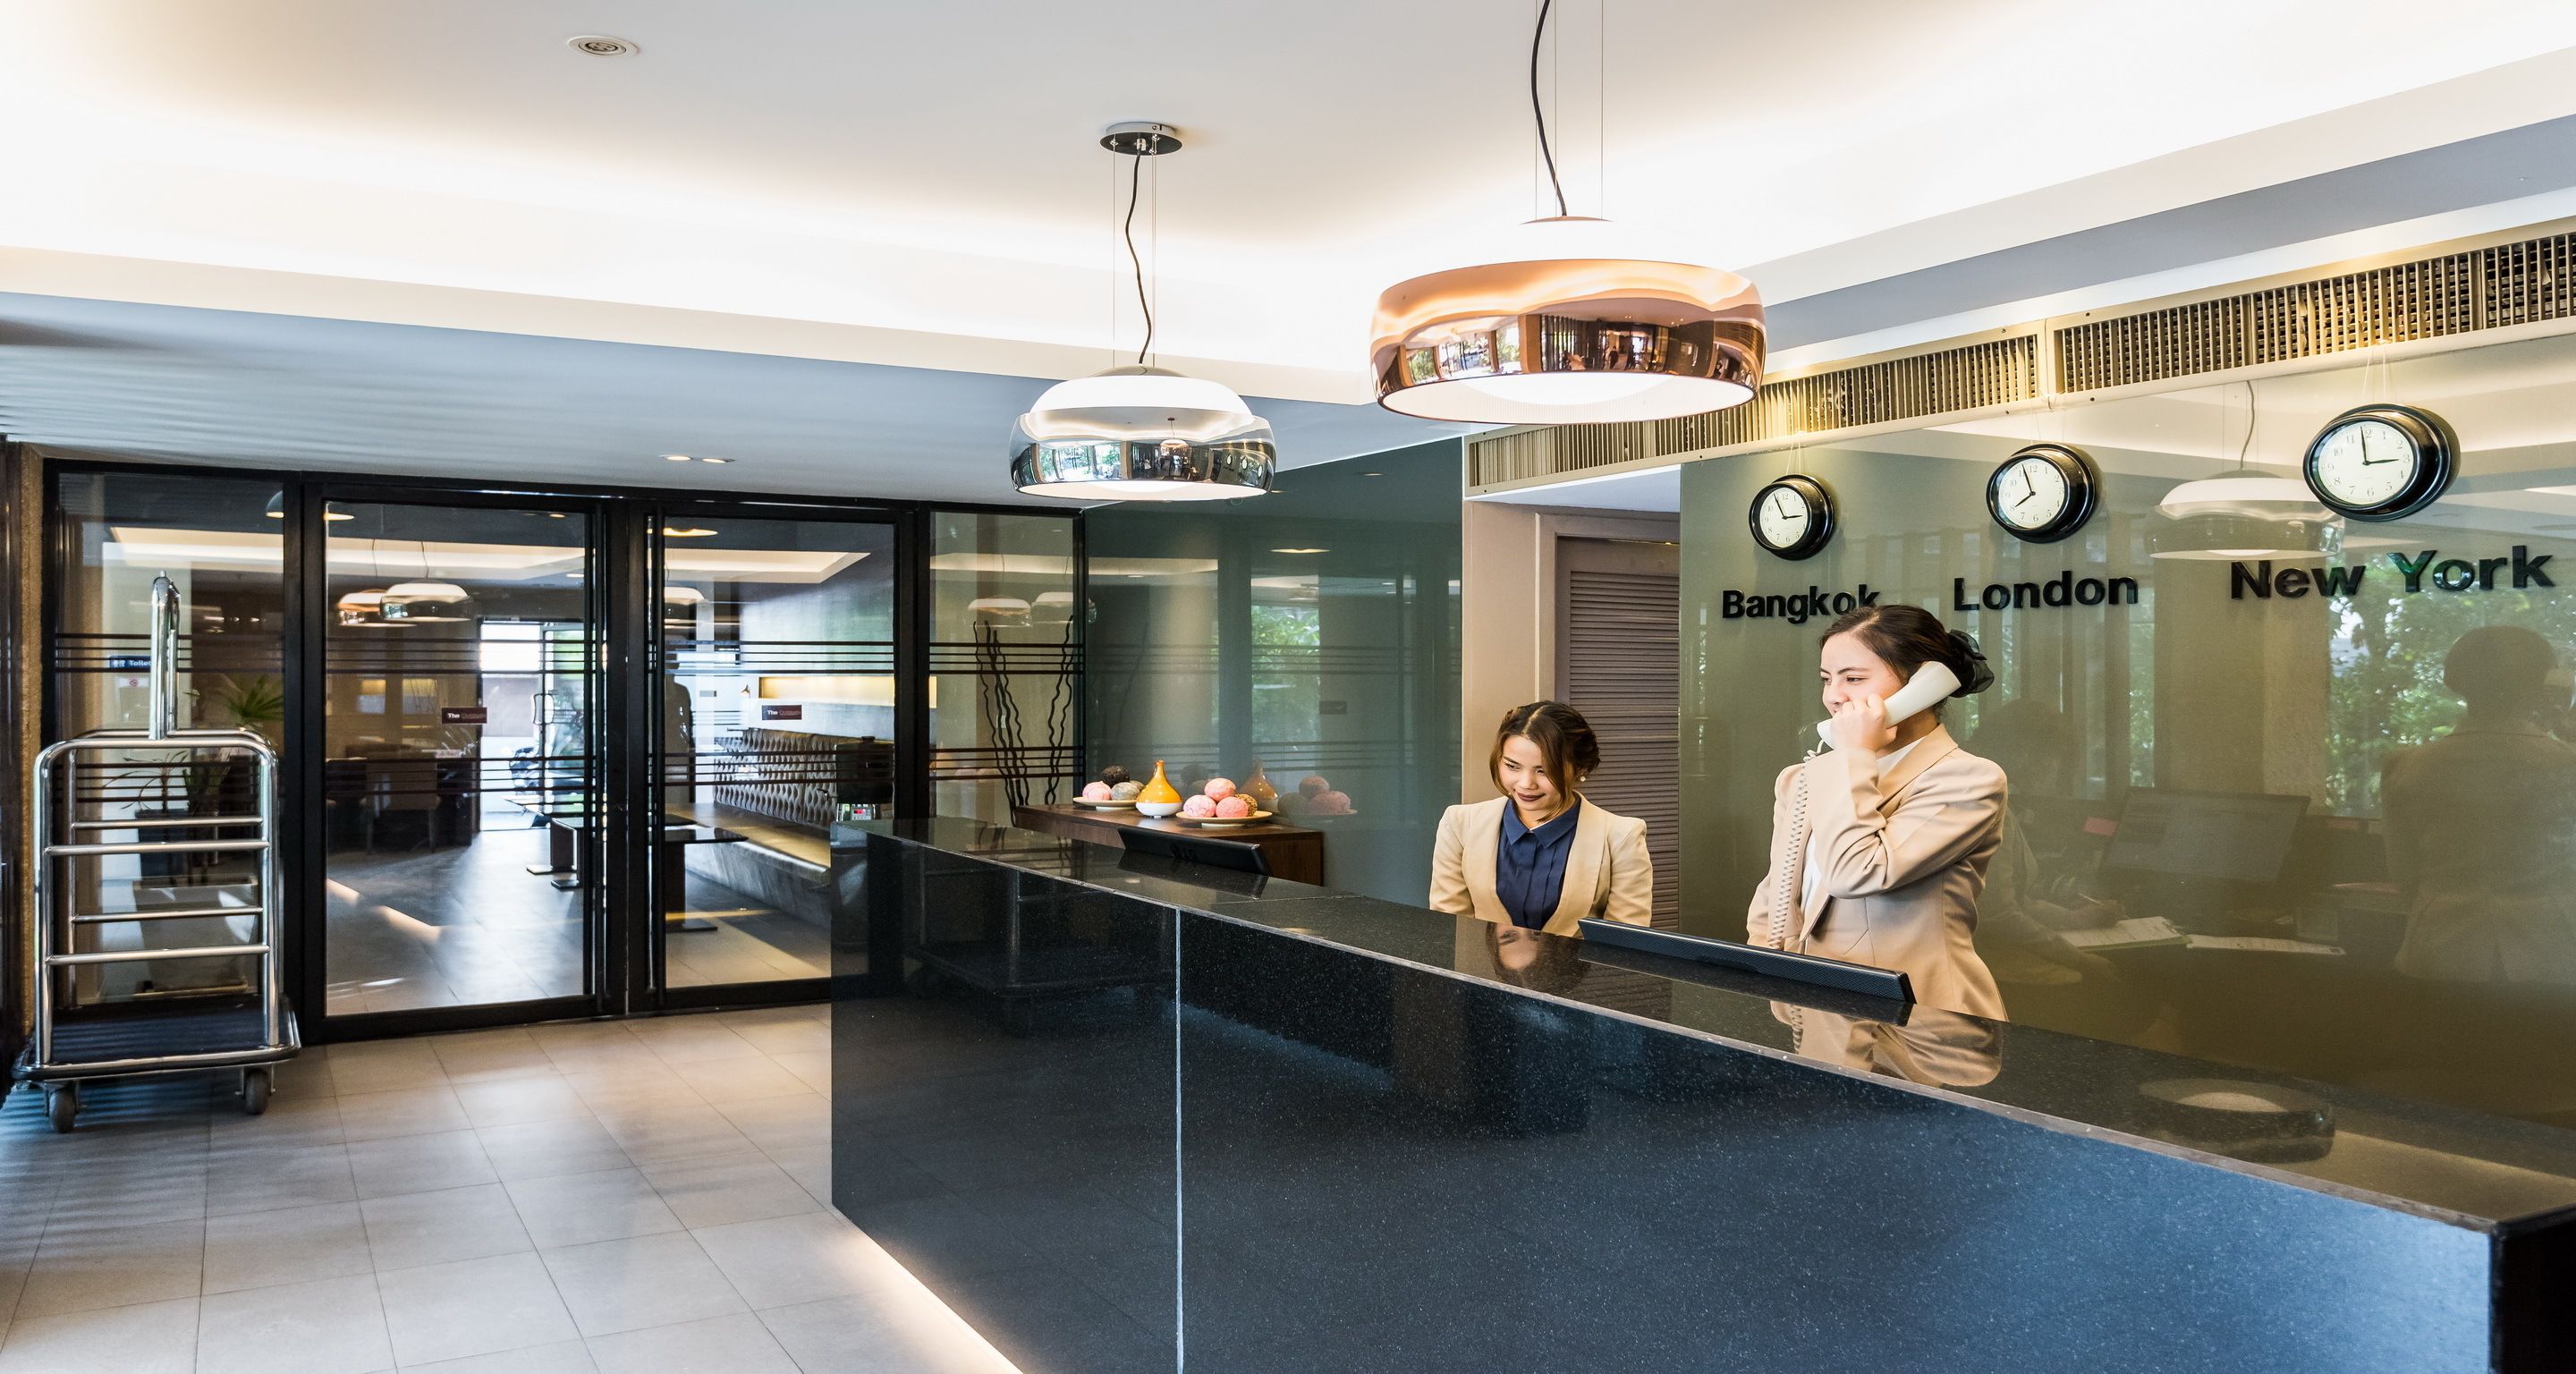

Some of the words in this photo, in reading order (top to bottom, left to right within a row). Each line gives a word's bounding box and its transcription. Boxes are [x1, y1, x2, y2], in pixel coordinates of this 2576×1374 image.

[2367, 488, 2375, 496] 6
[1953, 570, 2139, 612] London
[2231, 559, 2366, 599] New
[2386, 545, 2556, 593] York
[1722, 583, 1881, 624] Bangkok
